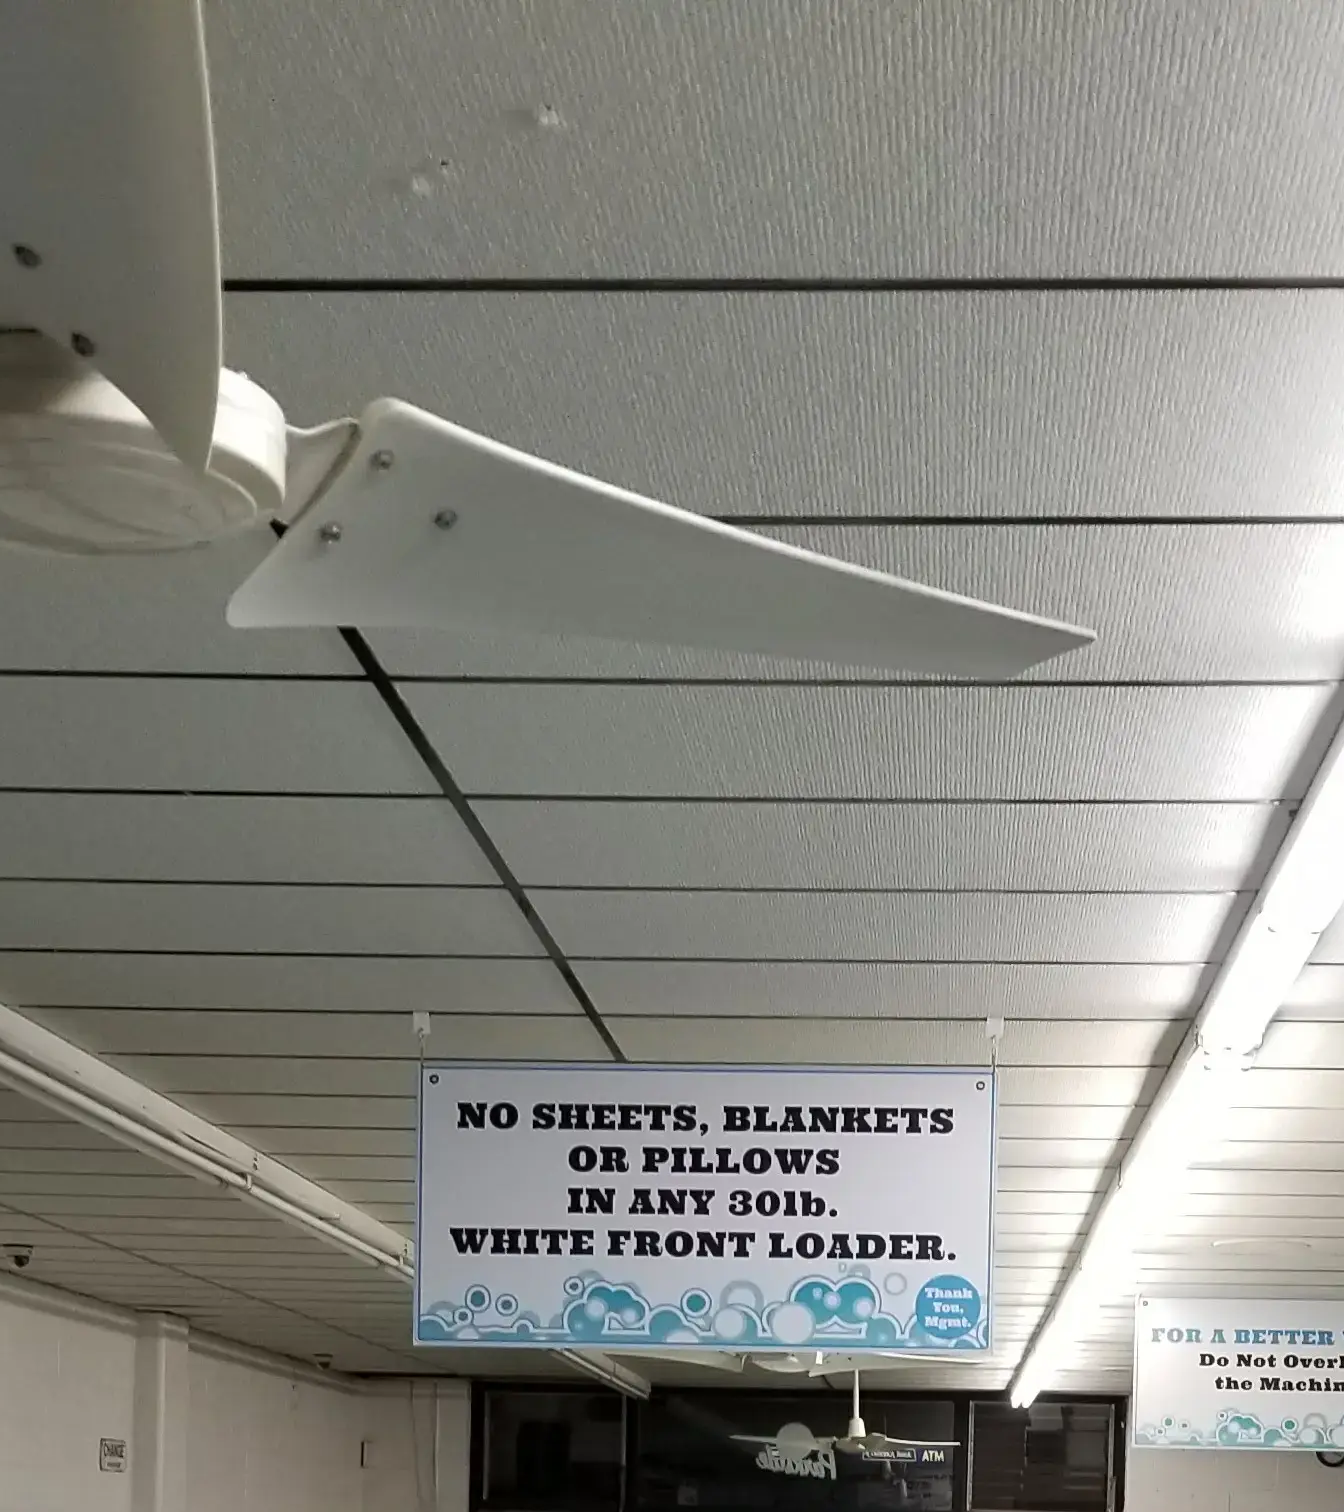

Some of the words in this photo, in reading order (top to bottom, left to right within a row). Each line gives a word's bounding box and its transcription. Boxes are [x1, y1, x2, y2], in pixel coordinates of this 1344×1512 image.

[457, 1101, 519, 1130] NO
[532, 1103, 710, 1137] SHEETS,
[722, 1106, 955, 1135] BLANKETS
[568, 1146, 630, 1174] OR
[641, 1147, 840, 1176] PILLOWS
[567, 1188, 616, 1216] IN
[629, 1188, 716, 1217] ANY
[728, 1190, 839, 1218] 30lb.
[450, 1228, 595, 1257] WHITE
[607, 1229, 756, 1259] FRONT
[768, 1232, 957, 1262] LOADER.
[924, 1287, 973, 1299] Thank
[933, 1302, 964, 1314] You,
[924, 1316, 972, 1331] Mgmt.
[1151, 1327, 1202, 1343] FOR
[1210, 1329, 1227, 1344] A
[1234, 1329, 1336, 1346] BETTER
[1199, 1353, 1230, 1368] Do
[1236, 1354, 1277, 1368] Not
[1214, 1376, 1253, 1391] the
[922, 1450, 945, 1462] ATM
